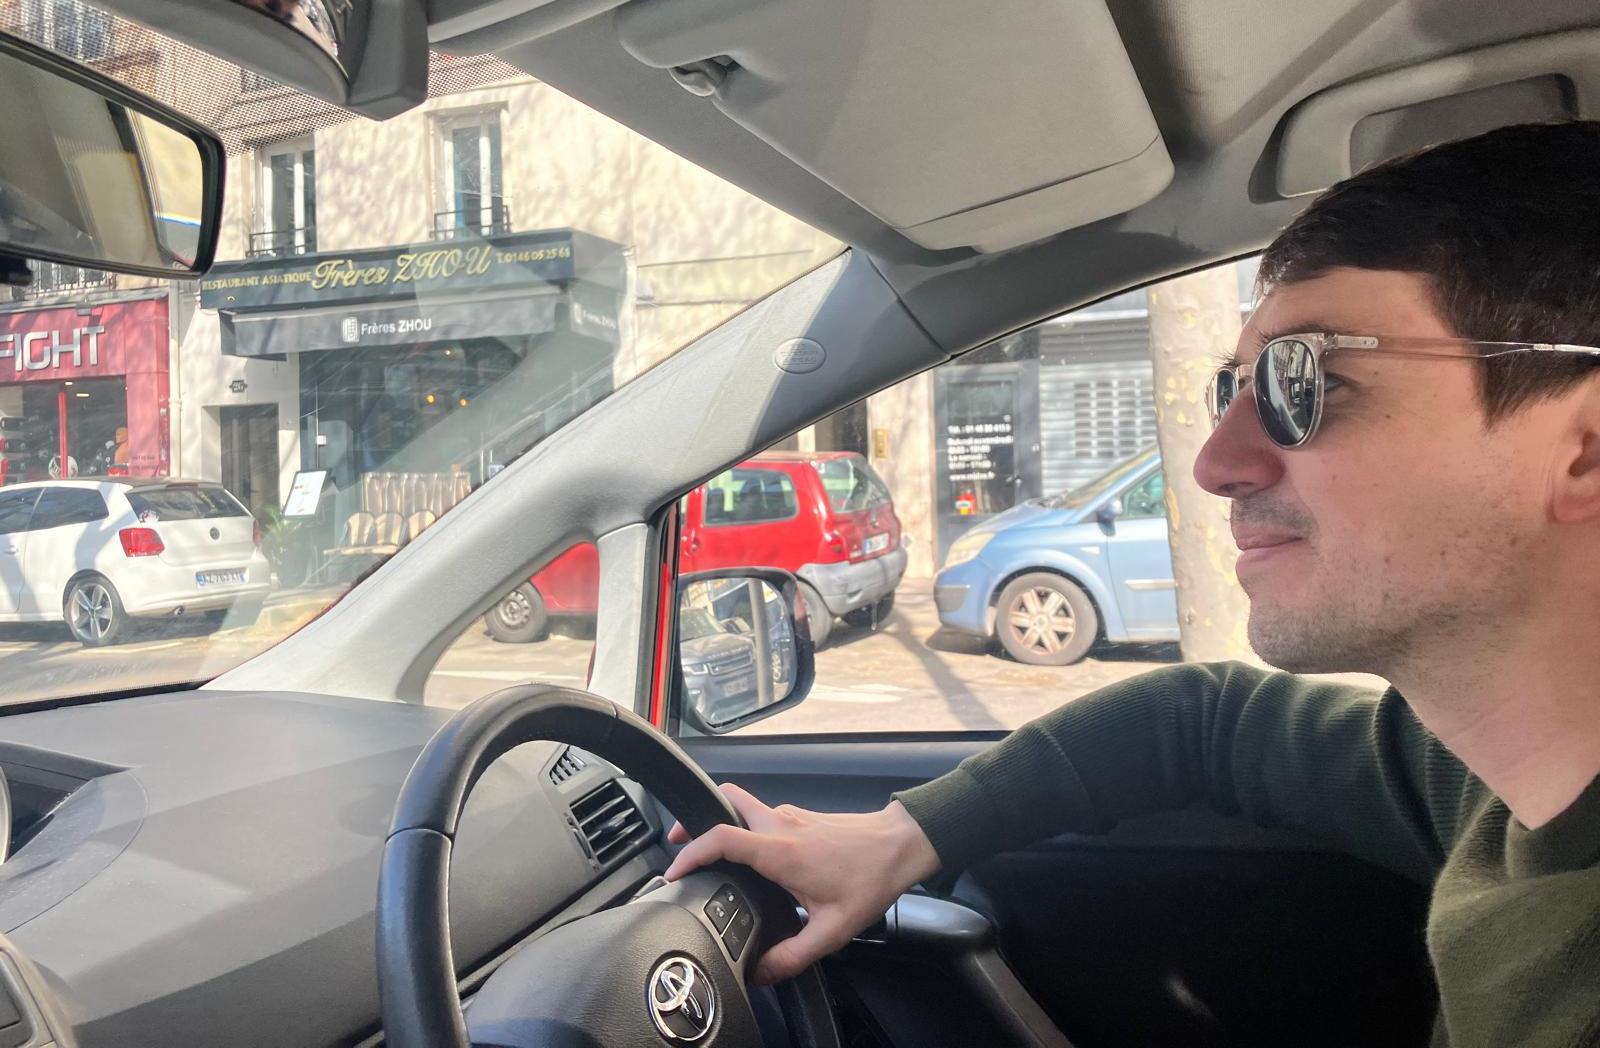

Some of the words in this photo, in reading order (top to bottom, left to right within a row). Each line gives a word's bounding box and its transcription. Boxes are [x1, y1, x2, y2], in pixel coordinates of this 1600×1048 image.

[202, 277, 259, 290] RESTAURANT
[262, 272, 313, 285] ASIATIQUE
[311, 259, 390, 290] Frères
[393, 246, 493, 283] ZHOU
[361, 322, 396, 335] Frères
[398, 318, 432, 333] ZHOU
